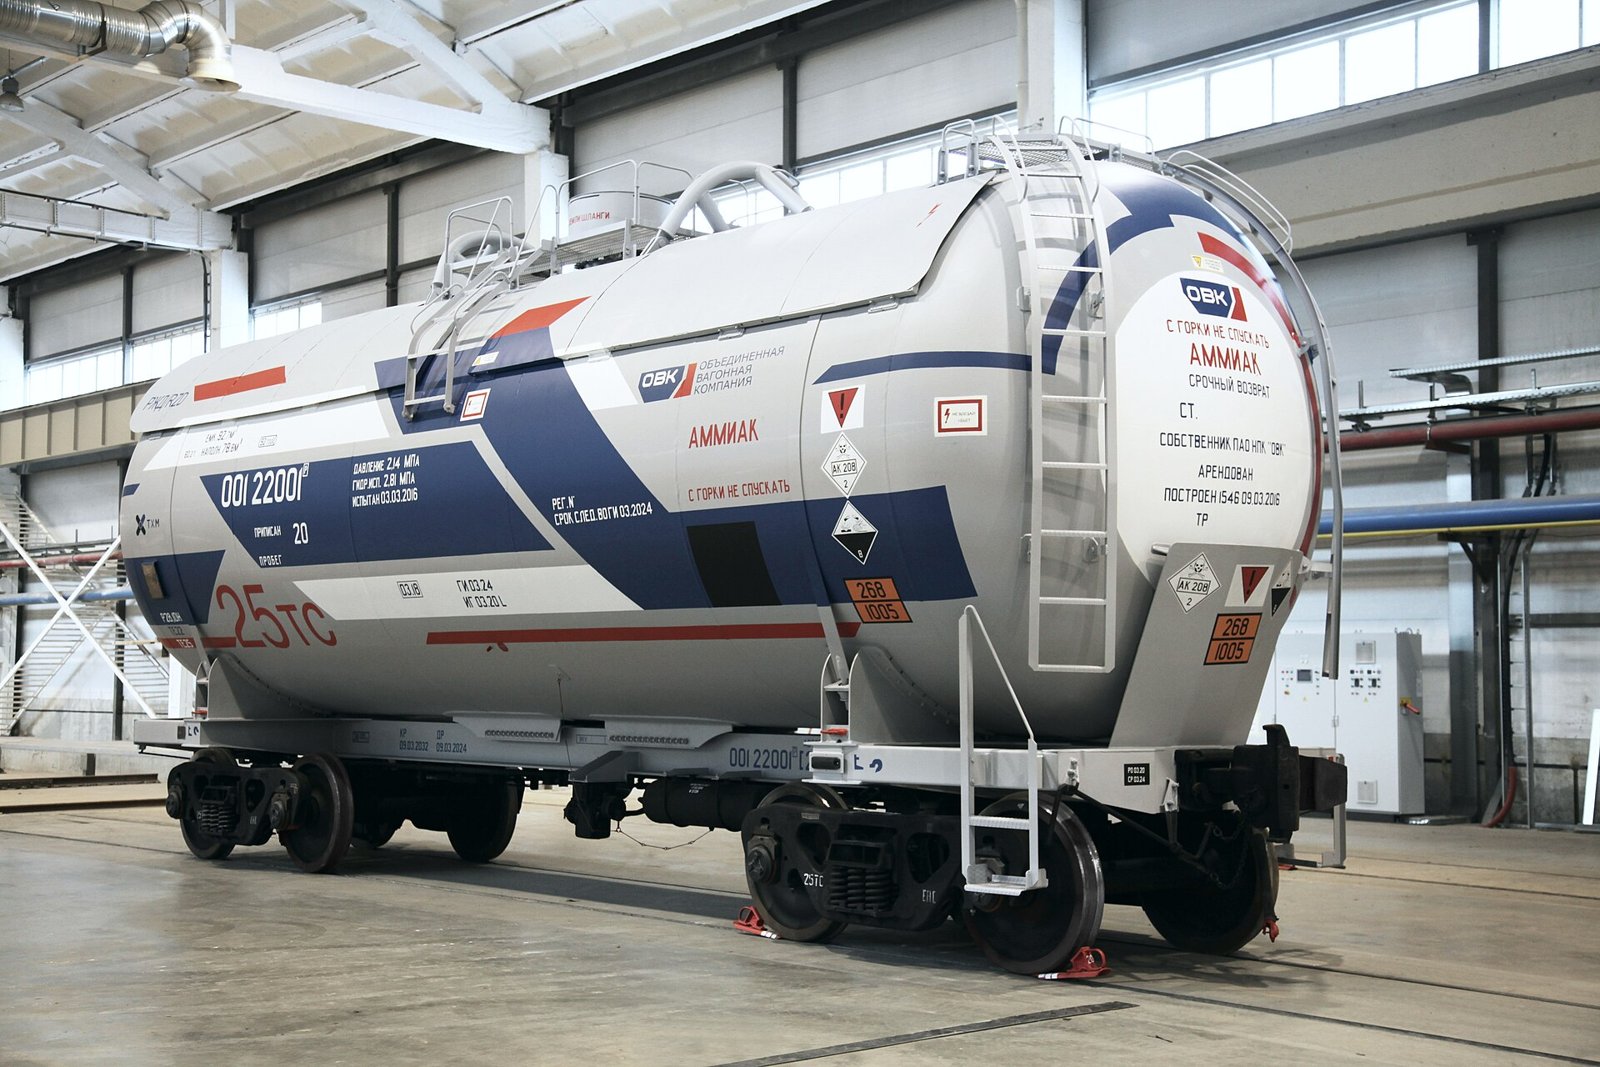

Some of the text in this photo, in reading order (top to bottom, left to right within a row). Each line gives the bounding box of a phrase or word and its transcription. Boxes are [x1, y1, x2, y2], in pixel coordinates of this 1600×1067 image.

[1186, 285, 1228, 306] ОВК
[1166, 319, 1270, 349] С ГОРКИ НЕ СПУСКАТЬ
[699, 346, 785, 370] ОБЪЕДИНЕННАЯ
[1190, 342, 1262, 376] АММИАК
[642, 368, 677, 388] ОВК
[696, 364, 753, 383] ВАГОННАЯ
[693, 376, 753, 395] КОМПАНИЯ
[1189, 372, 1270, 399] СРОЧНЫЙ ВОЗВРАТ
[688, 419, 759, 449] АММИАК
[1160, 432, 1231, 451] СОБСТВЕННИК
[1233, 438, 1250, 453] ПАО
[1252, 441, 1266, 454] НПК
[353, 460, 385, 475] ДАВЛЕНИЕ
[832, 463, 842, 474] АК
[1198, 464, 1254, 481] АРЕНДОВАН
[688, 479, 790, 502] С ГОРКИ НЕ СПУСКАТЬ
[844, 479, 849, 489] 2
[352, 487, 418, 507] ИСПЫТАН 03.03.2016
[1164, 487, 1217, 504] ПОСТРОЕН
[1219, 490, 1240, 504] 1546
[554, 511, 574, 526] СРОК
[619, 501, 653, 518] 03.2024
[1196, 512, 1208, 527] ТР
[254, 522, 309, 545] ПРИПИСАН 20
[258, 554, 283, 567] ПРОБЕГ
[469, 579, 494, 592] 03.24
[856, 581, 887, 599] 268
[1178, 580, 1190, 591] АК
[1186, 597, 1192, 606] 2
[865, 603, 900, 621] 1005
[1222, 617, 1250, 637] 268
[1214, 641, 1245, 661] 1005
[803, 873, 824, 888] 25ТС
